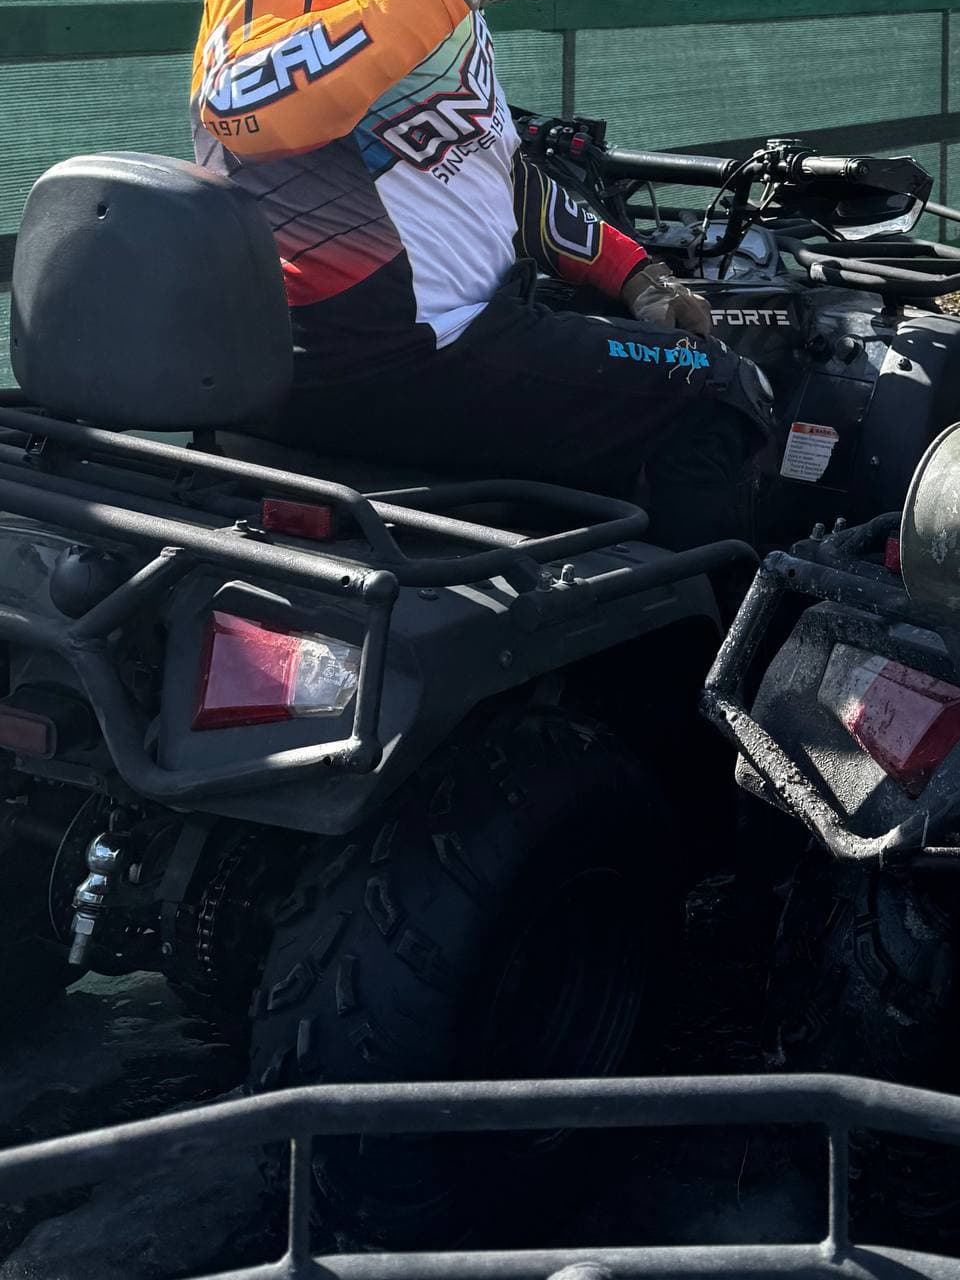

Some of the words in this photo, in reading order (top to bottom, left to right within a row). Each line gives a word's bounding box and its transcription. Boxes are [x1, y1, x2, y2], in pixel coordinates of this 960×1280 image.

[208, 115, 260, 137] 1970
[432, 130, 497, 185] SINCE
[710, 309, 790, 326] FORTE
[607, 339, 660, 365] RUN
[664, 347, 710, 369] FOR
